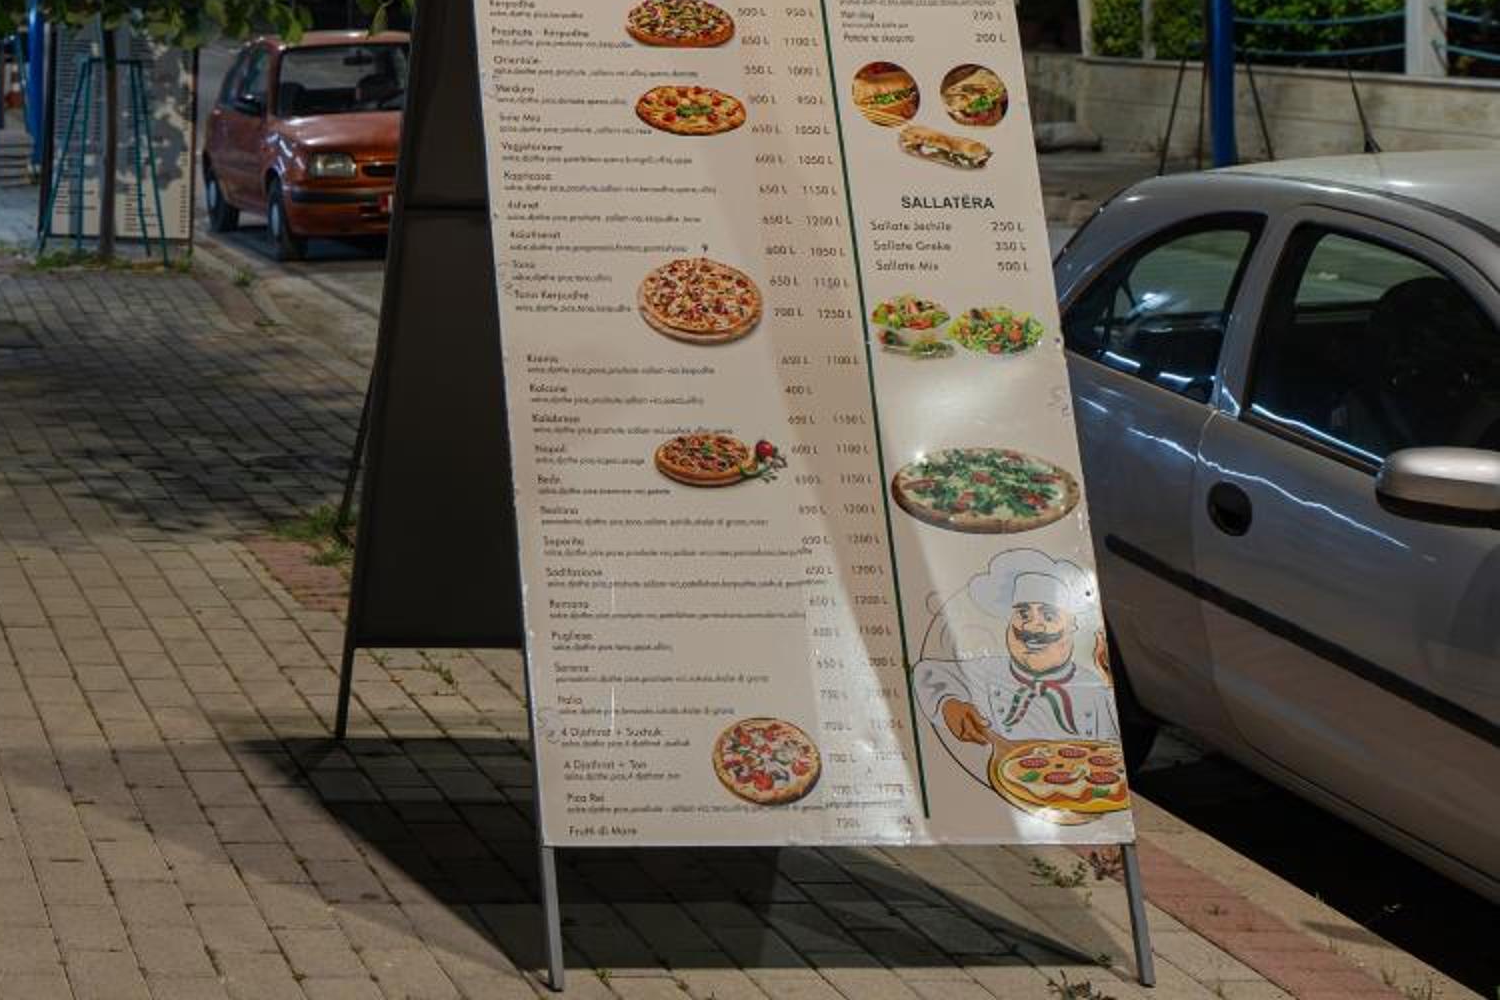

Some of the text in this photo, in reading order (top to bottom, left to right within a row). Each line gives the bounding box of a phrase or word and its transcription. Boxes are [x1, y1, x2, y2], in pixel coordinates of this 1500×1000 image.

[870, 220, 910, 231] Sallate
[990, 221, 1015, 232] 250
[873, 240, 951, 251] Sallate Greke
[875, 260, 915, 271] Sallate
[997, 260, 1021, 272] 500
[769, 275, 791, 287] 650
[817, 308, 845, 319] 1250
[784, 385, 804, 395] 400
